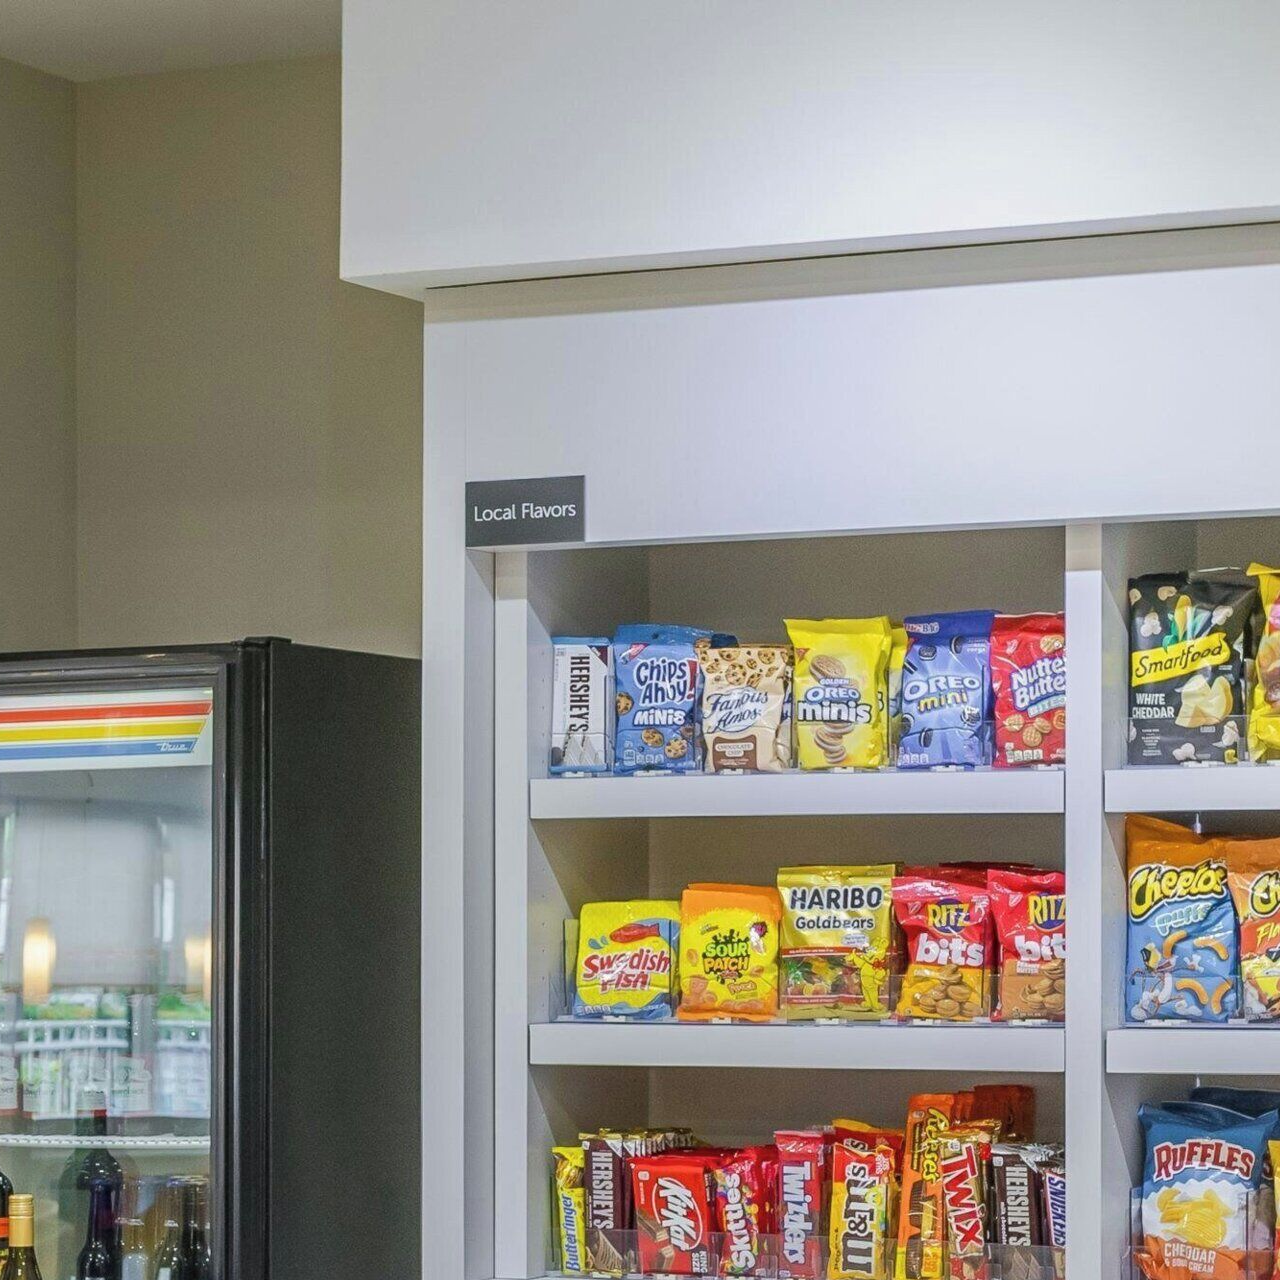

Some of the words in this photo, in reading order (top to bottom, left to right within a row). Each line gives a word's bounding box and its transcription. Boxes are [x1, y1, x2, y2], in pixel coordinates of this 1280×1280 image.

[474, 502, 517, 523] Local
[521, 499, 577, 521] Flavors
[635, 657, 687, 685] Chips
[1011, 657, 1066, 690] Nutte
[1134, 641, 1223, 678] Smartfood
[570, 653, 590, 732] HERSHEY'S
[641, 664, 698, 706] Ahoy!
[806, 687, 861, 701] OREO
[904, 676, 980, 700] OREO
[1015, 675, 1066, 708] Butte
[704, 686, 769, 719] Famous
[797, 700, 871, 723] minis
[917, 690, 969, 713] mini
[1132, 705, 1175, 719] CHEDDAR
[1136, 693, 1166, 706] WHITE
[156, 741, 188, 752] True
[789, 887, 883, 910] HARIBO
[1129, 865, 1228, 920] Cheetos
[795, 915, 875, 931] Goldbears
[927, 901, 970, 927] RITZ
[705, 942, 749, 957] SOUR
[915, 934, 983, 966] bits
[1014, 933, 1066, 961] bit
[583, 948, 670, 980] Swedish
[703, 956, 750, 974] PATCH
[600, 971, 649, 993] Fish
[1154, 1140, 1255, 1181] RUFFLES
[592, 1152, 613, 1230] HERSHEY'S
[941, 1144, 985, 1253] TWIX
[1005, 1166, 1031, 1246] HERSHEY'S
[560, 1194, 581, 1272] Butterfinger
[725, 1174, 756, 1269] Skittles
[1164, 1243, 1217, 1264] CHEDDAR
[1188, 1262, 1214, 1274] CREAM
